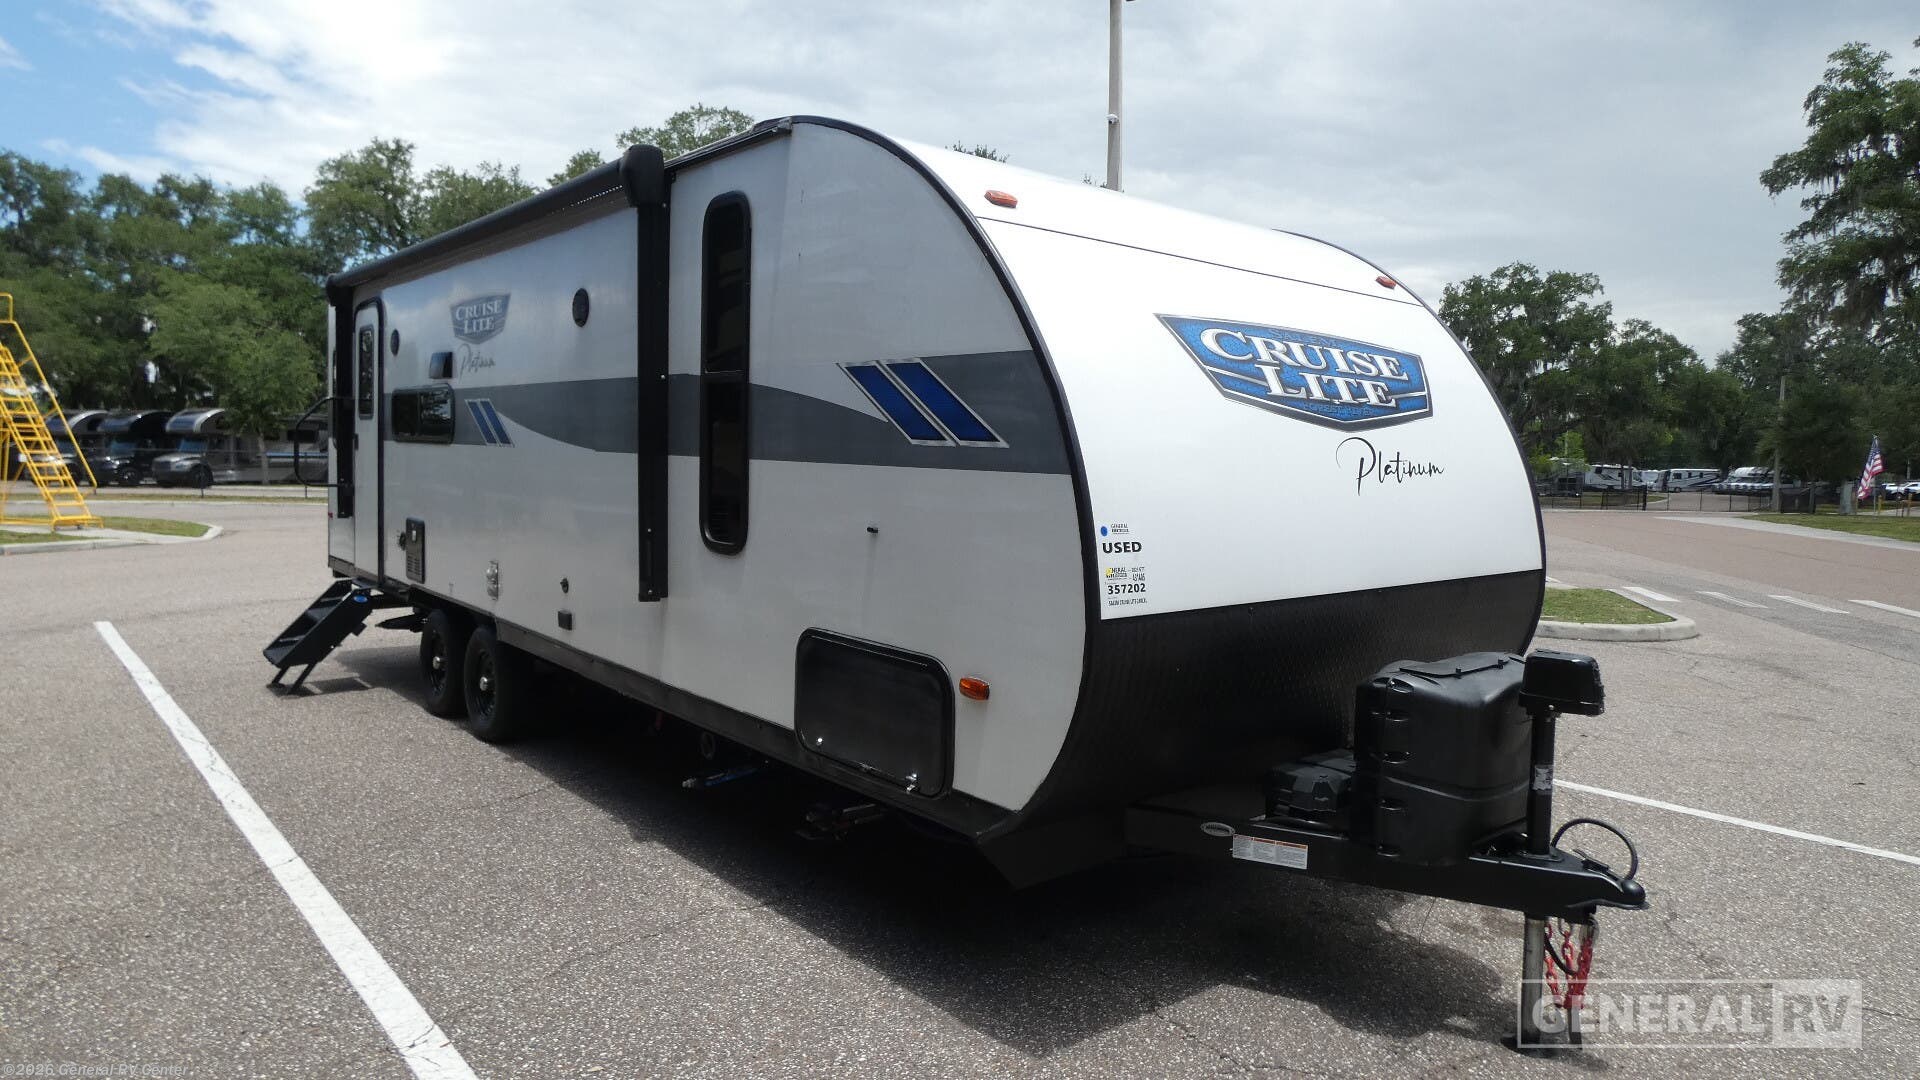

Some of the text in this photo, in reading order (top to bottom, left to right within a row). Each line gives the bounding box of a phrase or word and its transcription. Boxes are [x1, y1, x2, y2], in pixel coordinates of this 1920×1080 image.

[455, 299, 503, 321] CRUISE
[463, 316, 495, 334] LITE
[1199, 327, 1408, 381] CRUISE
[1254, 363, 1397, 408] LITE
[1335, 437, 1445, 496] Platinum
[1102, 541, 1142, 554] USED
[1107, 583, 1146, 595] 357202
